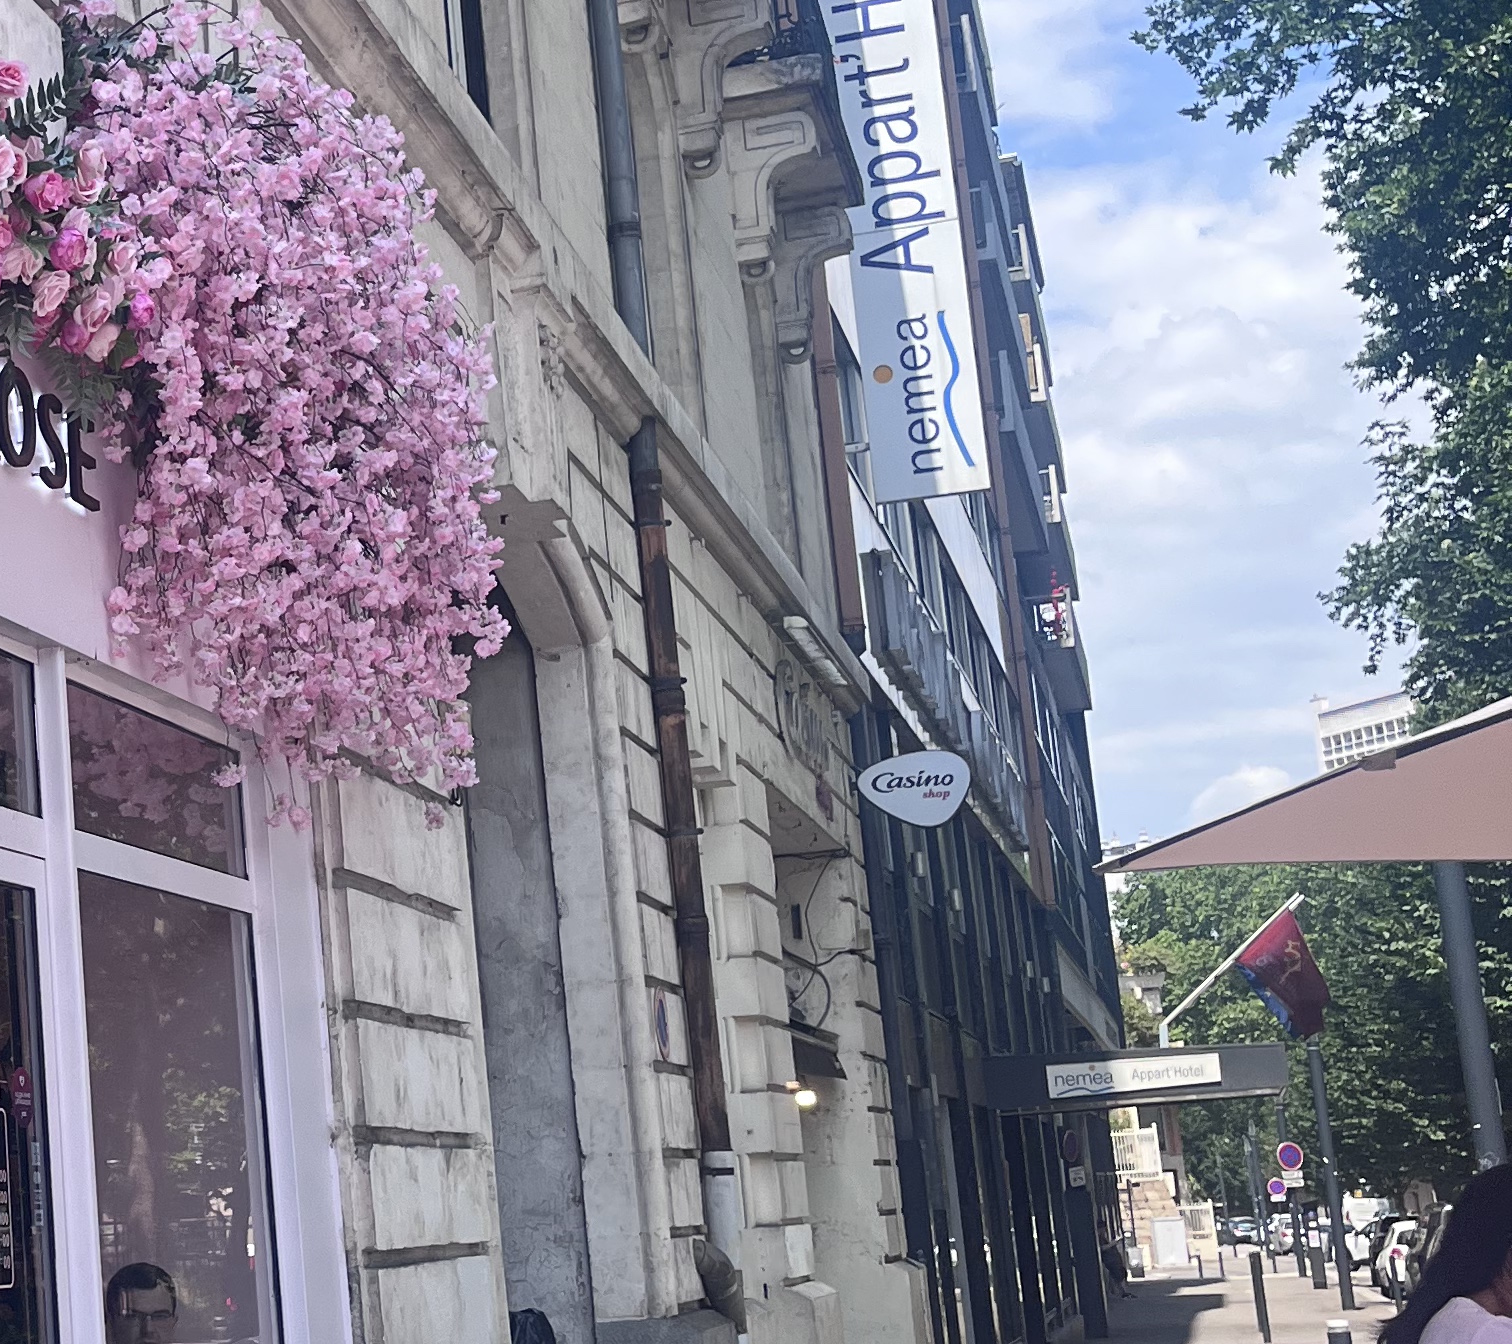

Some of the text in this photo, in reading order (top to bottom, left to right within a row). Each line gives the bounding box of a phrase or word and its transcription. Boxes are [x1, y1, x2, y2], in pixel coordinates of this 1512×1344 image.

[896, 312, 944, 475] nemea
[870, 770, 955, 794] Casino
[922, 788, 951, 800] shop
[1054, 1071, 1115, 1087] nemea
